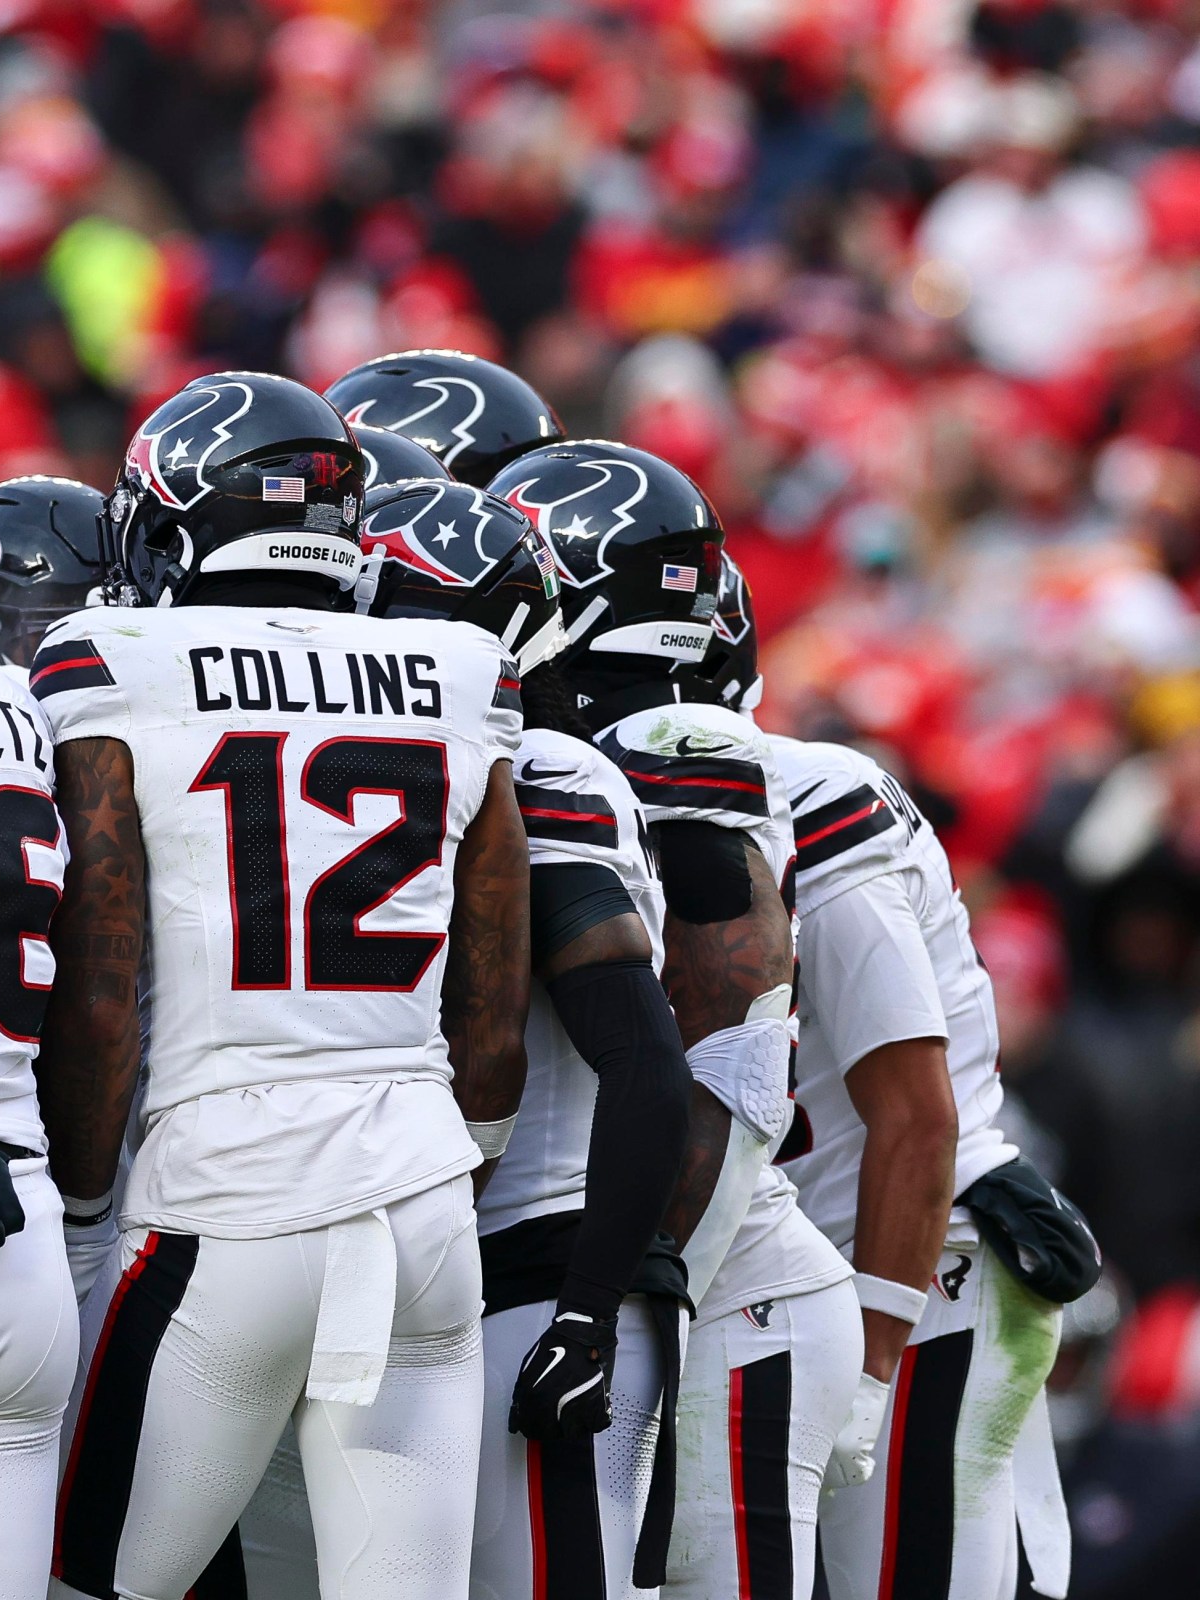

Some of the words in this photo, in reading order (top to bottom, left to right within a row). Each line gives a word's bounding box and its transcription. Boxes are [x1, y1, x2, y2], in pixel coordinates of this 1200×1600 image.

[269, 545, 329, 561] CHOOSE
[331, 549, 356, 568] LOVE
[660, 633, 705, 650] CHOOSE
[188, 646, 442, 718] COLLINS
[187, 731, 450, 992] 12
